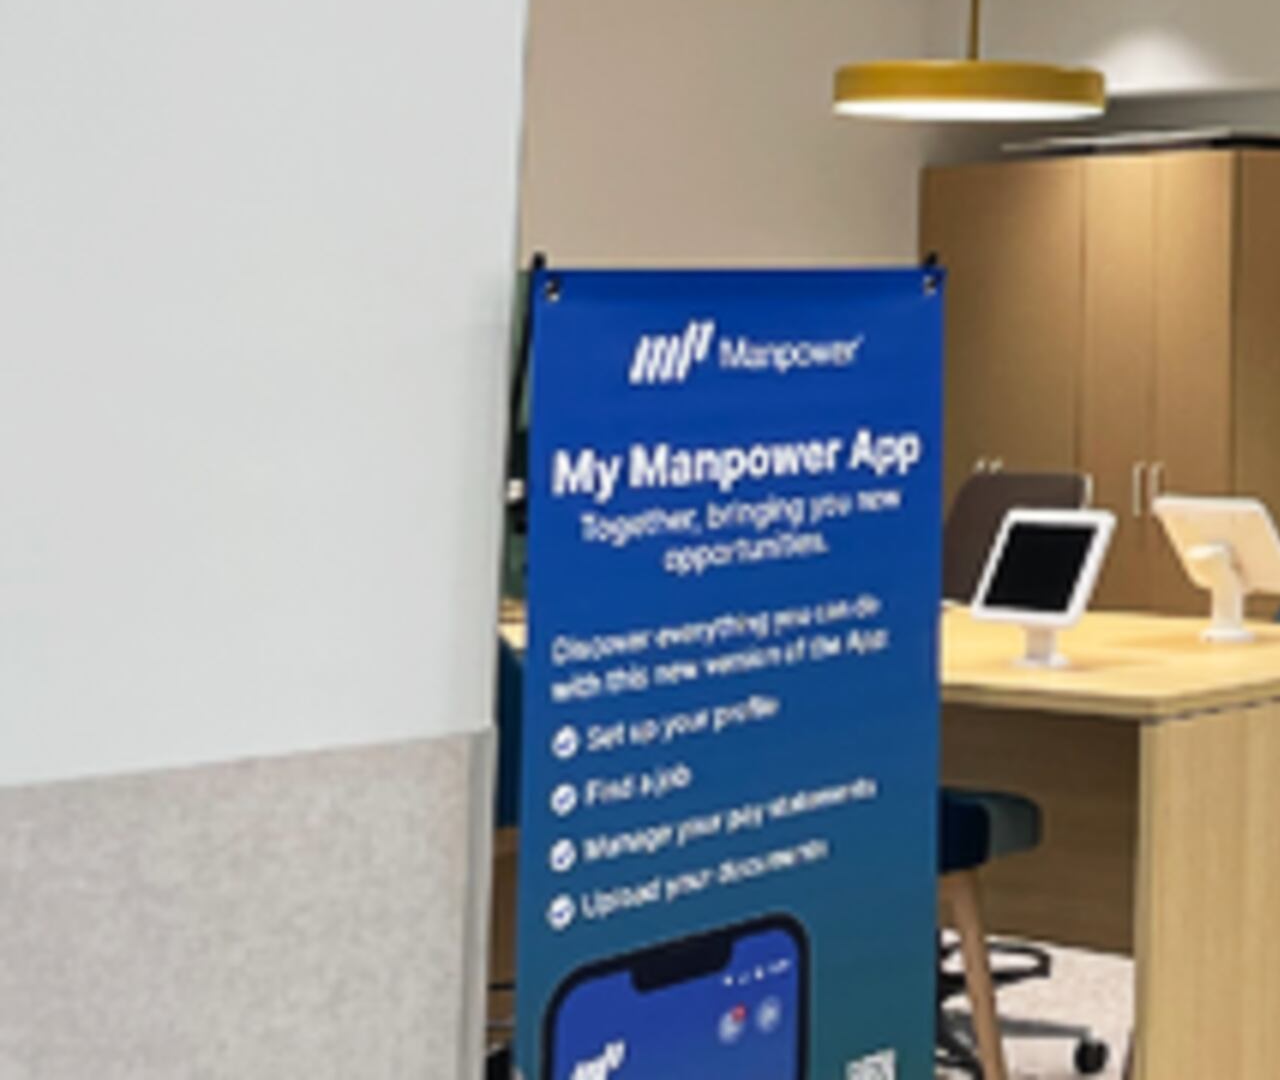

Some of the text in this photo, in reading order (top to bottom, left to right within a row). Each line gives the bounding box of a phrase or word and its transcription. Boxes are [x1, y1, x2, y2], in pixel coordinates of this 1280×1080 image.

[551, 429, 920, 504] My Manpower App
[580, 490, 901, 547] Together, bringing you new
[663, 532, 830, 575] opportunities.
[551, 593, 882, 667] Discover everything you can do
[551, 673, 600, 702] with
[605, 665, 649, 693] this
[654, 663, 697, 684] new
[705, 647, 781, 675] version
[785, 636, 805, 664] of
[808, 633, 841, 660] the
[586, 695, 779, 751] Set up your profile
[585, 775, 634, 805] Find
[652, 763, 692, 798] job
[582, 777, 878, 862] Manage your pay statements
[581, 840, 828, 919] Upload your documents
